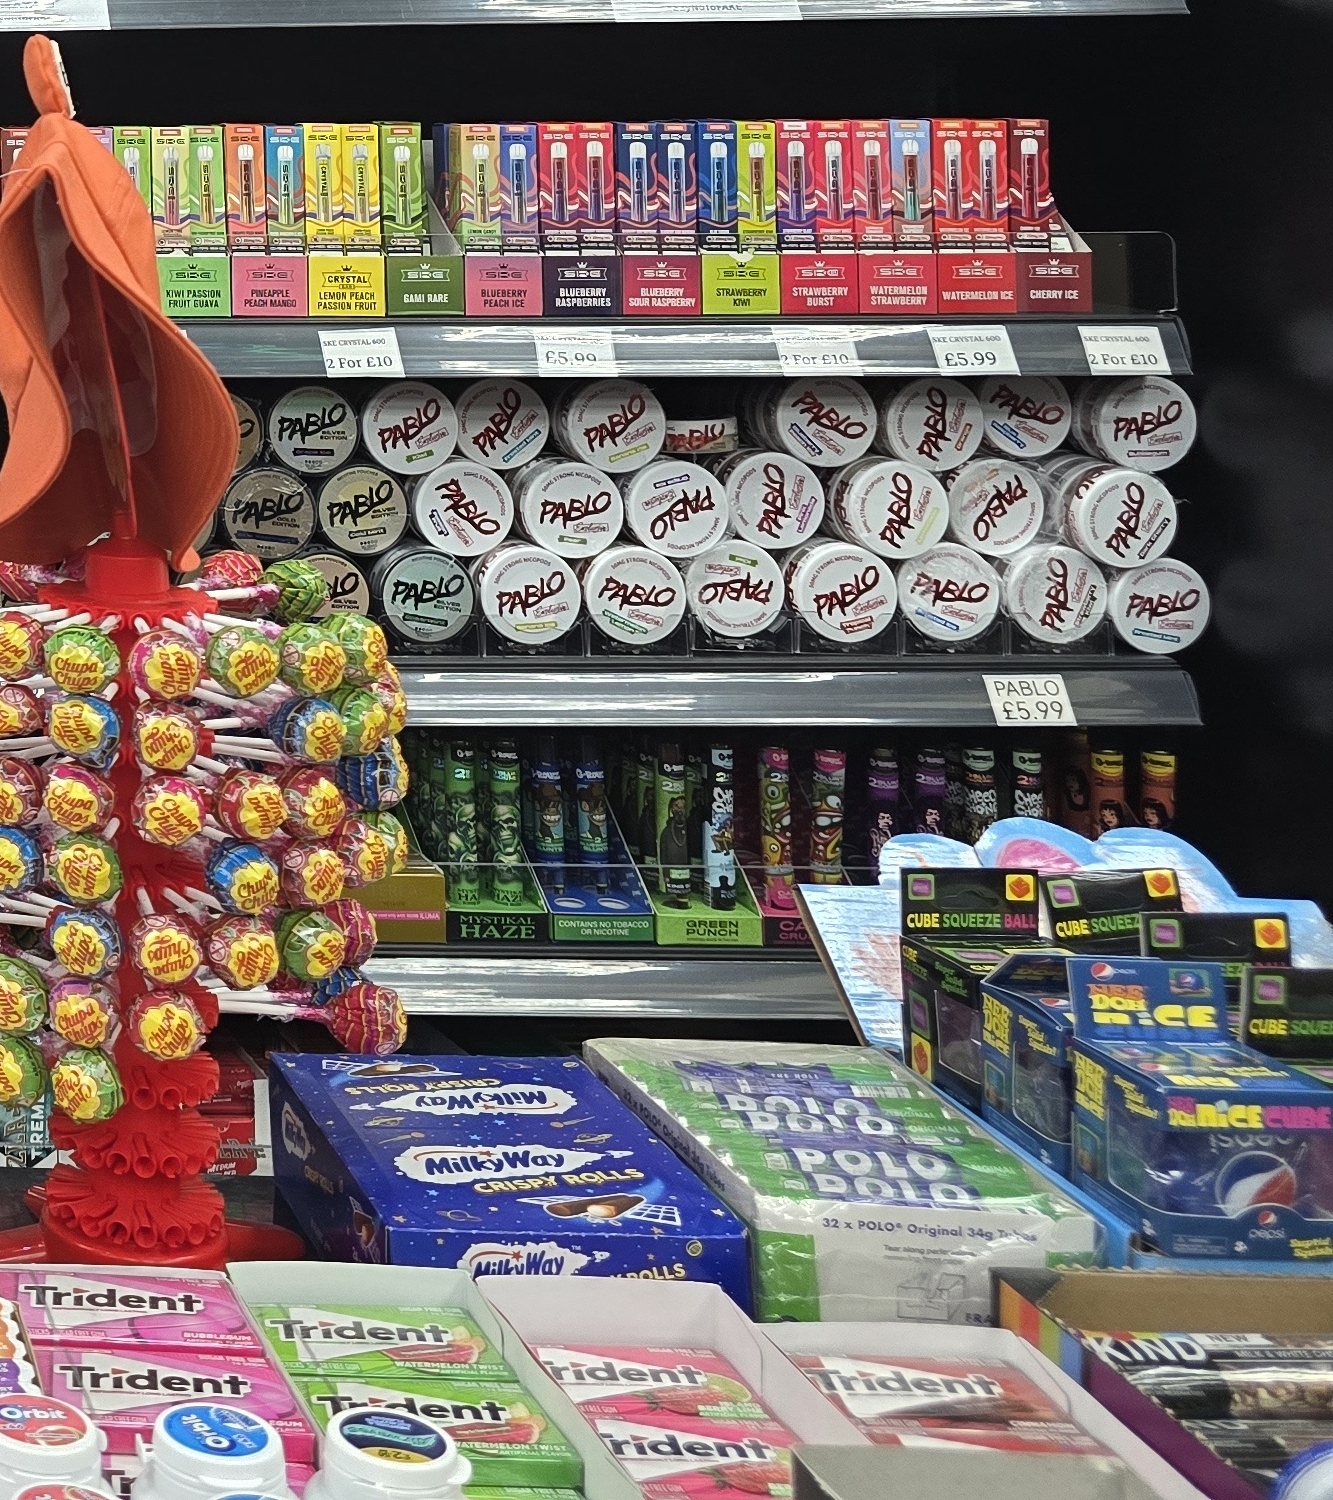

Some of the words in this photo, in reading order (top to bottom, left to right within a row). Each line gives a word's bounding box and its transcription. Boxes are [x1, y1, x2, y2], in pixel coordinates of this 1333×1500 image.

[792, 286, 849, 297] STRAWBERRY
[1029, 290, 1061, 301] CHERRY
[1064, 289, 1079, 300] ICE
[806, 297, 834, 307] BURST
[338, 338, 371, 346] CRYSTAL
[326, 357, 335, 369] 2
[338, 356, 362, 369] For
[366, 355, 393, 368] £10
[945, 351, 997, 368] £5.99
[277, 403, 348, 444] PABLO
[1113, 400, 1183, 443] PABLO
[994, 679, 1061, 697] PABLO
[1002, 701, 1063, 721] £5.99
[460, 915, 535, 927] MYSTIKAL
[558, 920, 591, 928] CONTAINS
[593, 920, 603, 928] NO
[606, 919, 650, 928] TOBACCO
[686, 920, 740, 929] GREEN
[906, 913, 940, 928] CUBE
[943, 912, 1001, 928] SQUEEZE
[1004, 913, 1037, 928] BALL
[460, 925, 536, 939] HAZE
[580, 928, 591, 936] OR
[593, 927, 630, 936] NICOTINE
[686, 928, 740, 937] PUNCH
[799, 1149, 952, 1179] POLO
[473, 1175, 557, 1194] CRISPY
[562, 1168, 645, 1187] ROLLS
[822, 1218, 839, 1229] 32
[843, 1221, 853, 1230] x
[908, 1223, 964, 1238] Original
[967, 1227, 994, 1241] 34g
[24, 1285, 202, 1314] Trident
[267, 1318, 452, 1345] Trident
[1211, 1334, 1248, 1345] NEW
[1092, 1335, 1205, 1367] KIND
[395, 1361, 466, 1371] WATERMELON
[468, 1364, 506, 1373] TWIST
[803, 1367, 1001, 1399] Trident
